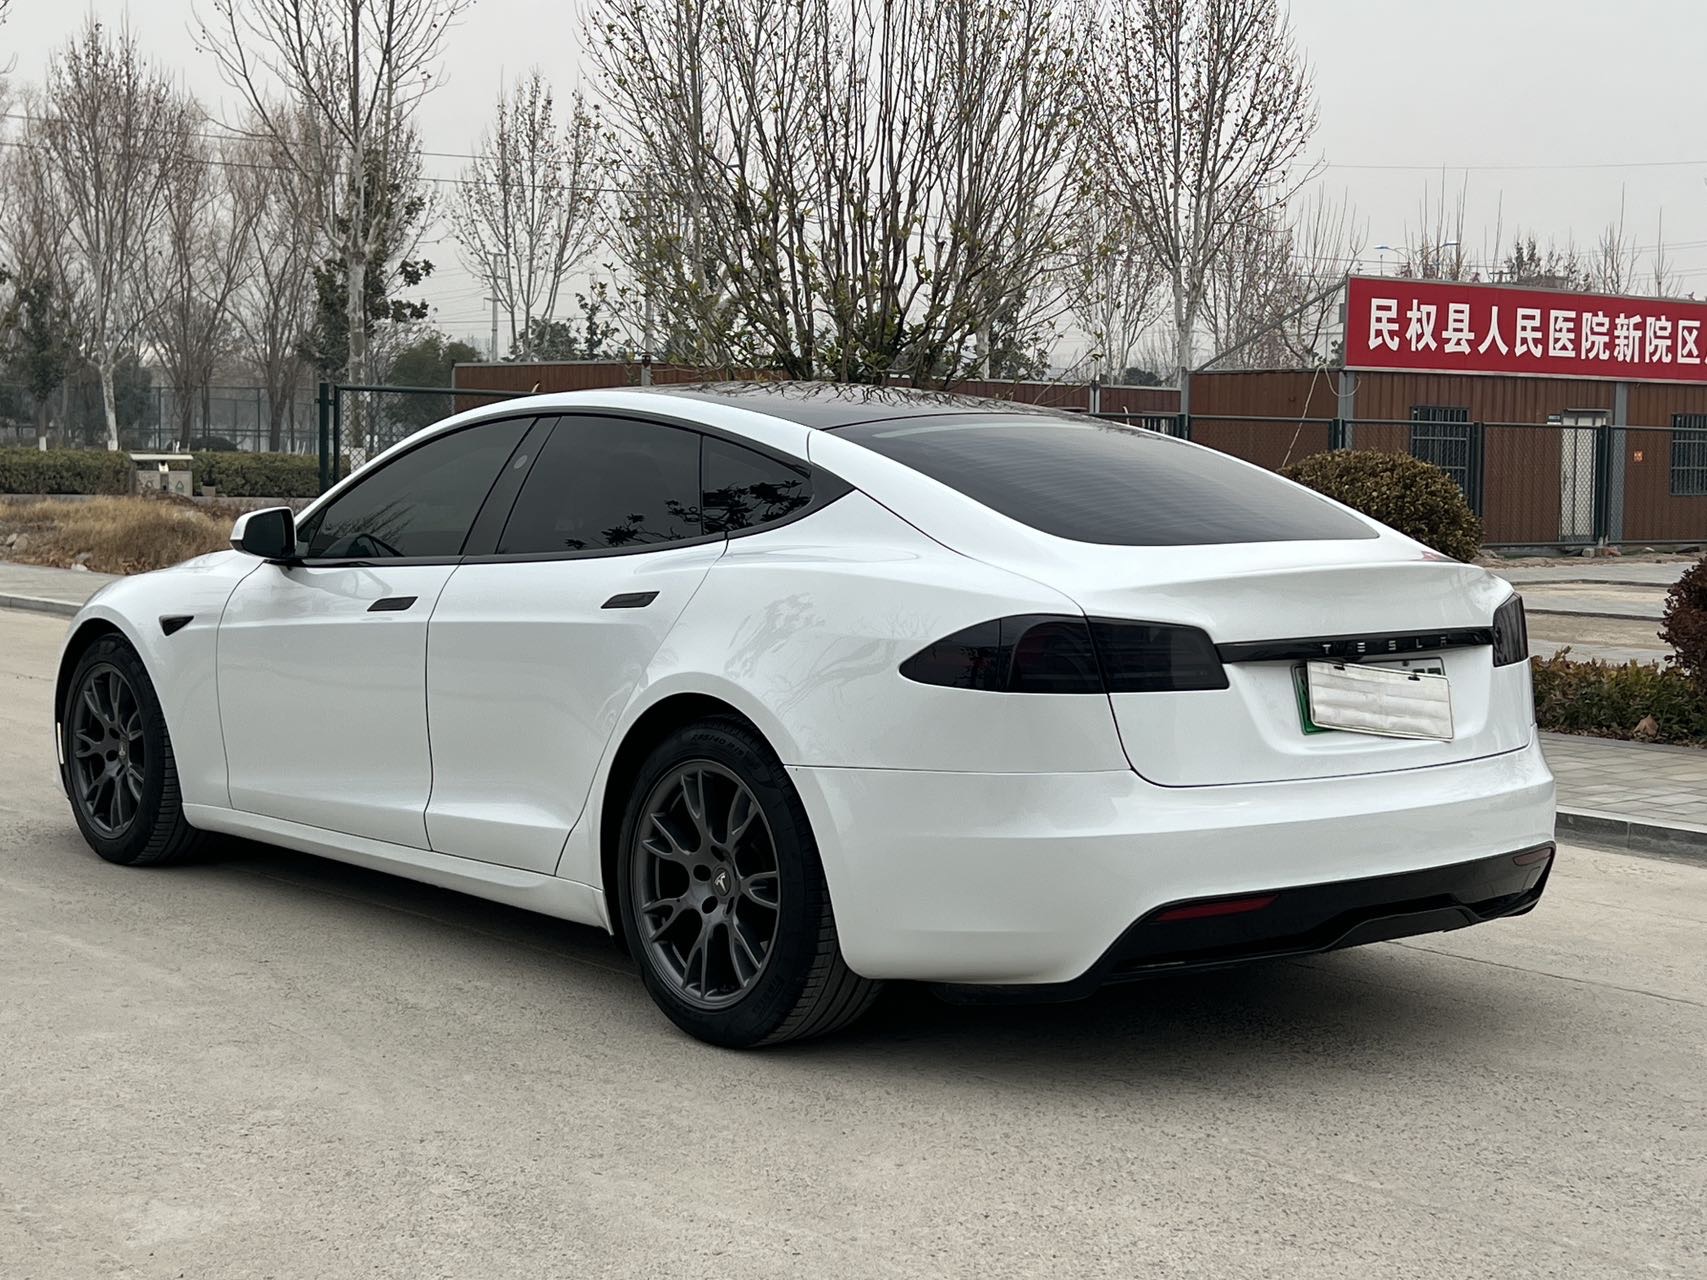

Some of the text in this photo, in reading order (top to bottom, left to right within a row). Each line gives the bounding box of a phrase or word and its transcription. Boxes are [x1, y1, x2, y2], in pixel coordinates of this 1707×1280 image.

[1367, 297, 1707, 365] 民权县人民医院新院区
[1322, 635, 1448, 655] TESLA
